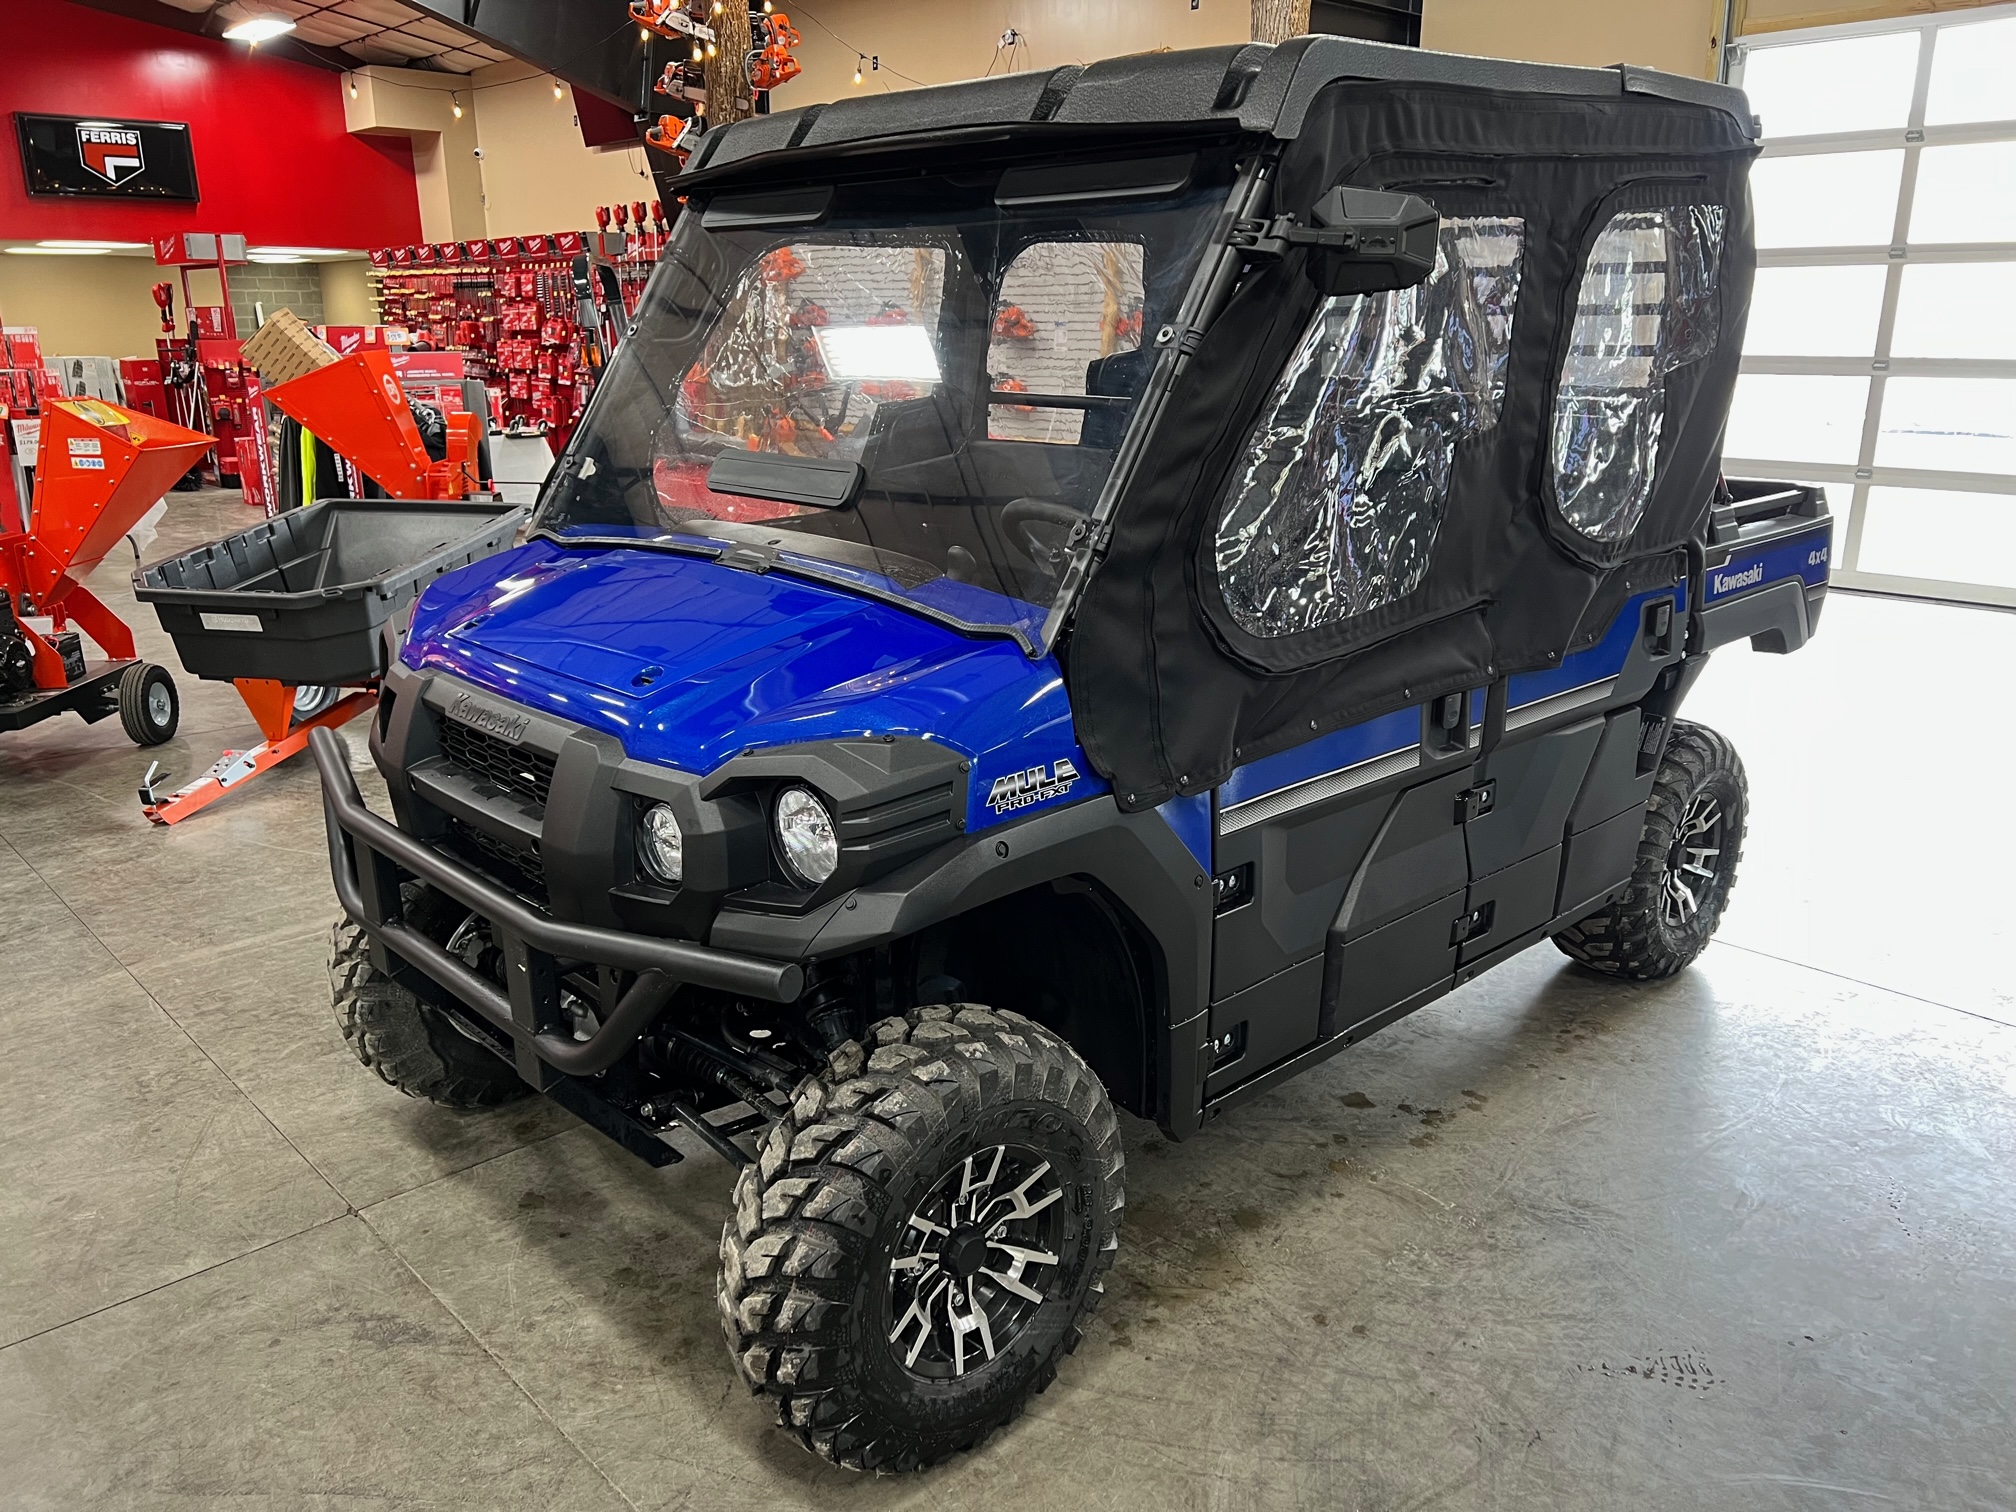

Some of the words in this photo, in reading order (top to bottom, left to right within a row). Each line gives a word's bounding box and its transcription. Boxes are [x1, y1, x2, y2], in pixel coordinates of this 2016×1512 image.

[80, 129, 137, 145] FERRIS
[1808, 546, 1828, 565] 4x4
[1713, 562, 1764, 594] Kawasaki
[448, 692, 531, 741] Kawasaki
[985, 758, 1081, 807] MULE
[995, 781, 1072, 815] PRO-FXT
